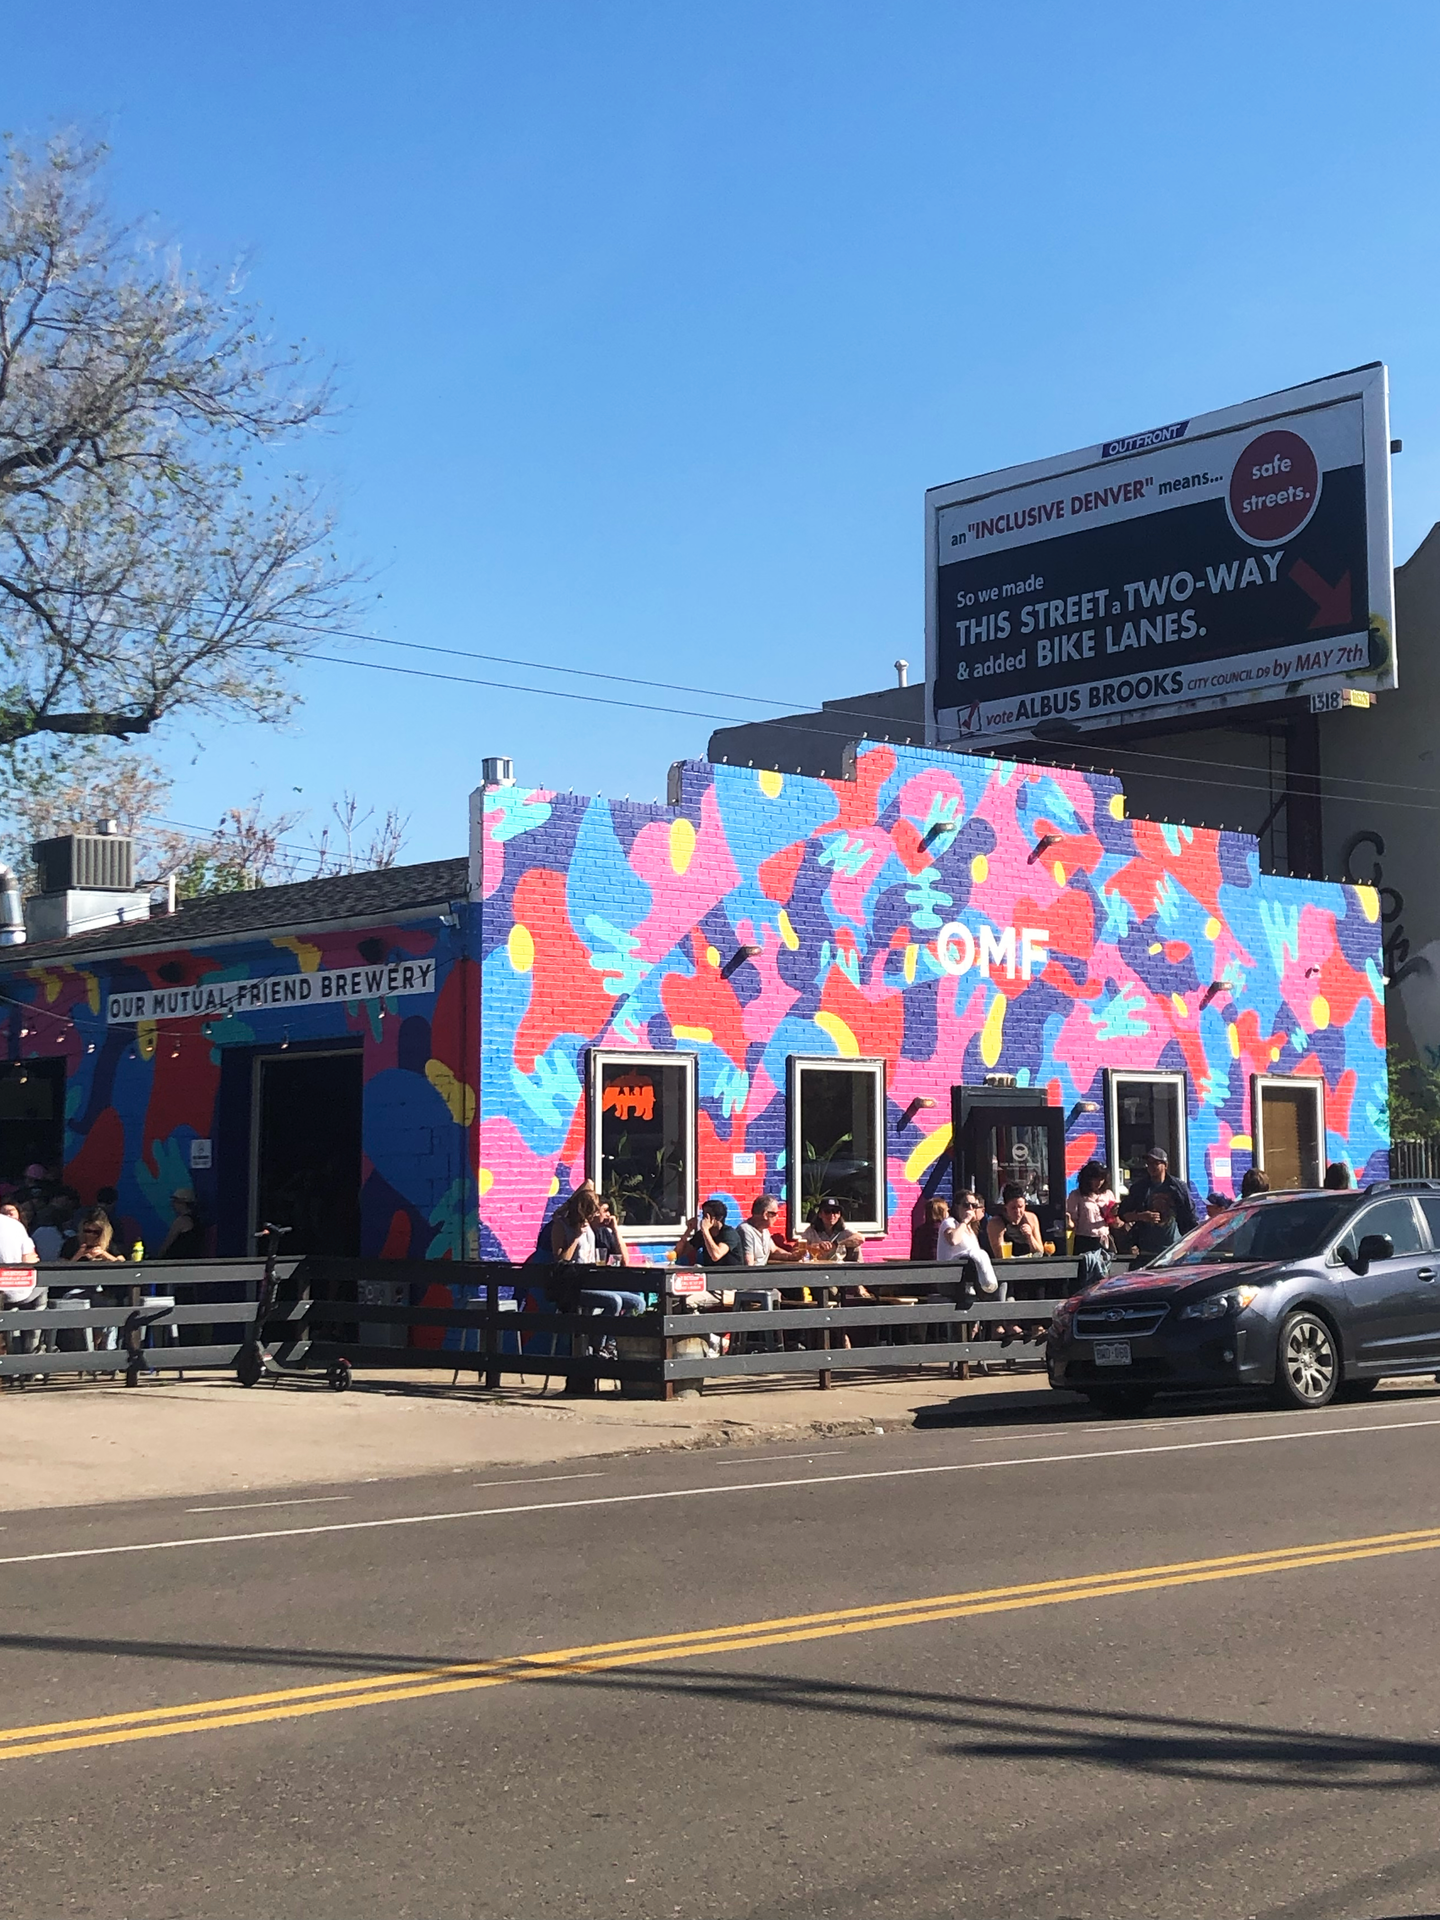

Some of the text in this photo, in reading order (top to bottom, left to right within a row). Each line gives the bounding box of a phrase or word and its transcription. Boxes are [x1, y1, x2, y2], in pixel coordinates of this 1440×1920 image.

[1109, 424, 1181, 455] OUTFRONT
[1252, 453, 1292, 480] safe
[951, 472, 1223, 546] an "INCLUSIVE DENVER" means...
[1242, 486, 1311, 513] streets.
[956, 551, 1285, 646] THIS STREET a TWO-WAY
[957, 573, 1044, 608] So we made
[957, 608, 1207, 680] & added BIKE LANES.
[986, 643, 1364, 726] vote ALBUS BROOKS CITY COUNCIL D9 by MAY 7th
[1312, 691, 1340, 712] 1318
[937, 921, 1050, 980] OMF
[110, 964, 432, 1018] OUR MUTUAL FRIEND BREWERY
